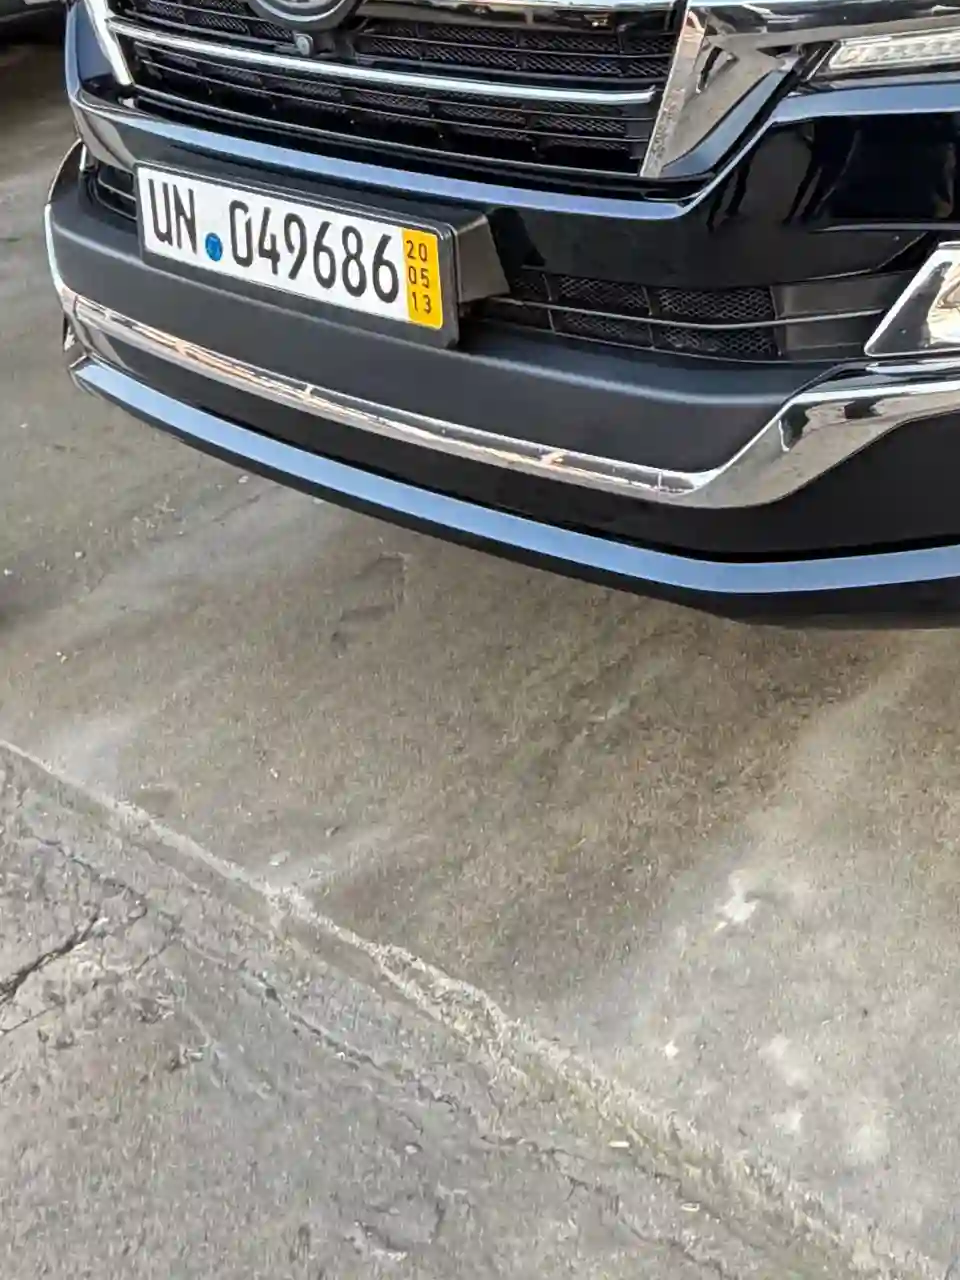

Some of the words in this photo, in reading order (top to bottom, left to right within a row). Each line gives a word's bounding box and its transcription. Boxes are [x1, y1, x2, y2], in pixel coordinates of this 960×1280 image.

[148, 178, 197, 254] UN
[229, 199, 400, 304] 049686
[405, 239, 428, 262] 20
[408, 265, 430, 287] 05
[412, 291, 432, 315] 13
